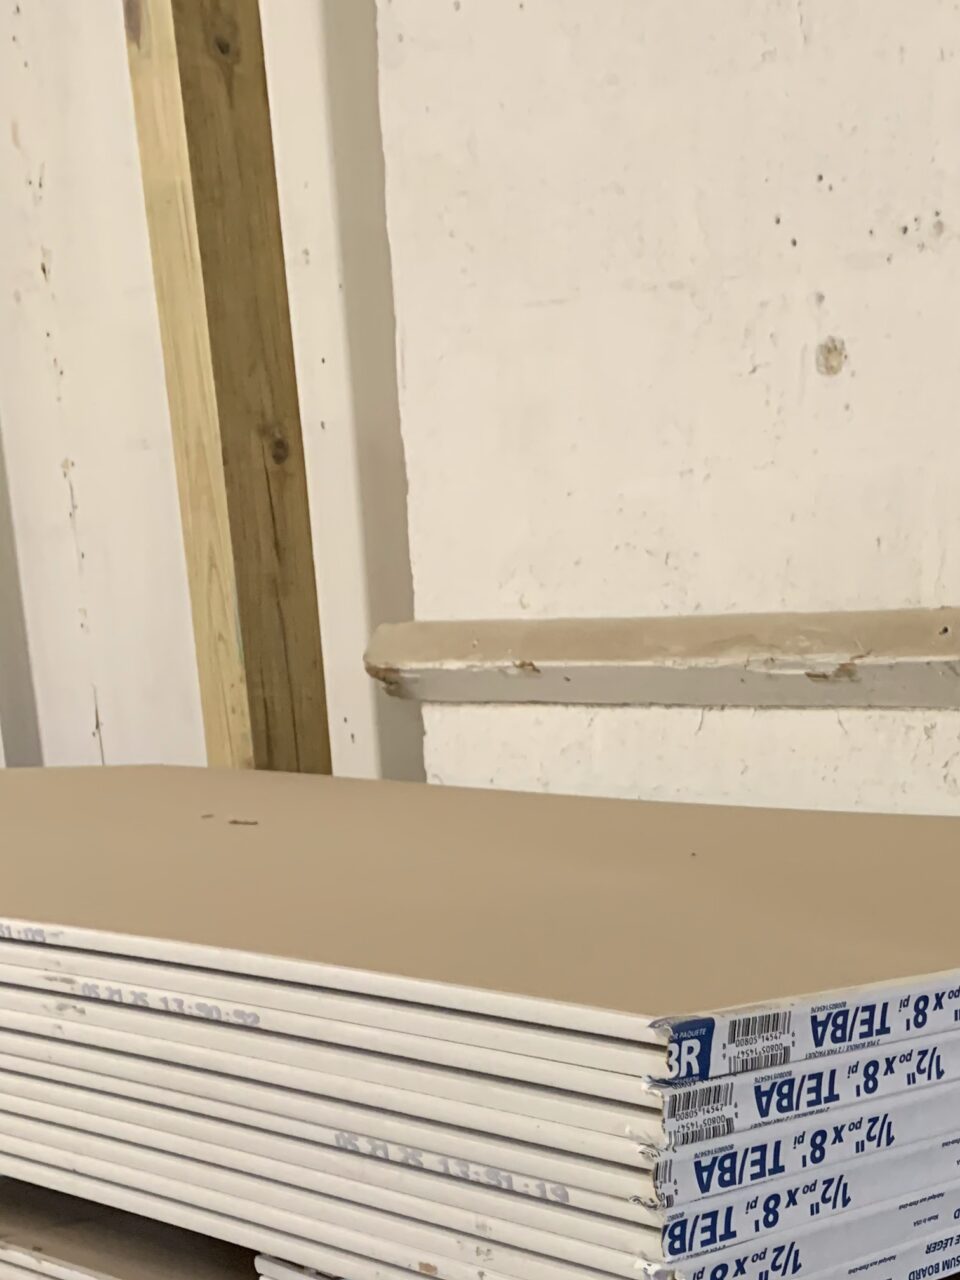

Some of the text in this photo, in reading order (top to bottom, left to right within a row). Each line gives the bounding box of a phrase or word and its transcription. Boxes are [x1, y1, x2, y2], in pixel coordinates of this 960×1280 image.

[933, 991, 945, 1011] x
[948, 985, 960, 999] po
[899, 995, 910, 1012] pi
[810, 1002, 891, 1048] TE/BA
[883, 1056, 896, 1076] x
[899, 1049, 913, 1064] po
[907, 1047, 945, 1085] 1/2"
[847, 1061, 859, 1078] pi
[754, 1068, 840, 1119] TE/BA
[831, 1124, 846, 1145] x
[848, 1117, 863, 1132] po
[855, 1113, 895, 1153] 1/2"
[793, 1131, 805, 1149] pi
[693, 1140, 785, 1194] TE/BA
[802, 1179, 817, 1195] po
[810, 1174, 851, 1216] 1/2"
[745, 1196, 758, 1214] pi
[785, 1187, 800, 1209] x
[662, 1206, 737, 1256] TE/B
[751, 1247, 768, 1264] po
[732, 1256, 749, 1277] x
